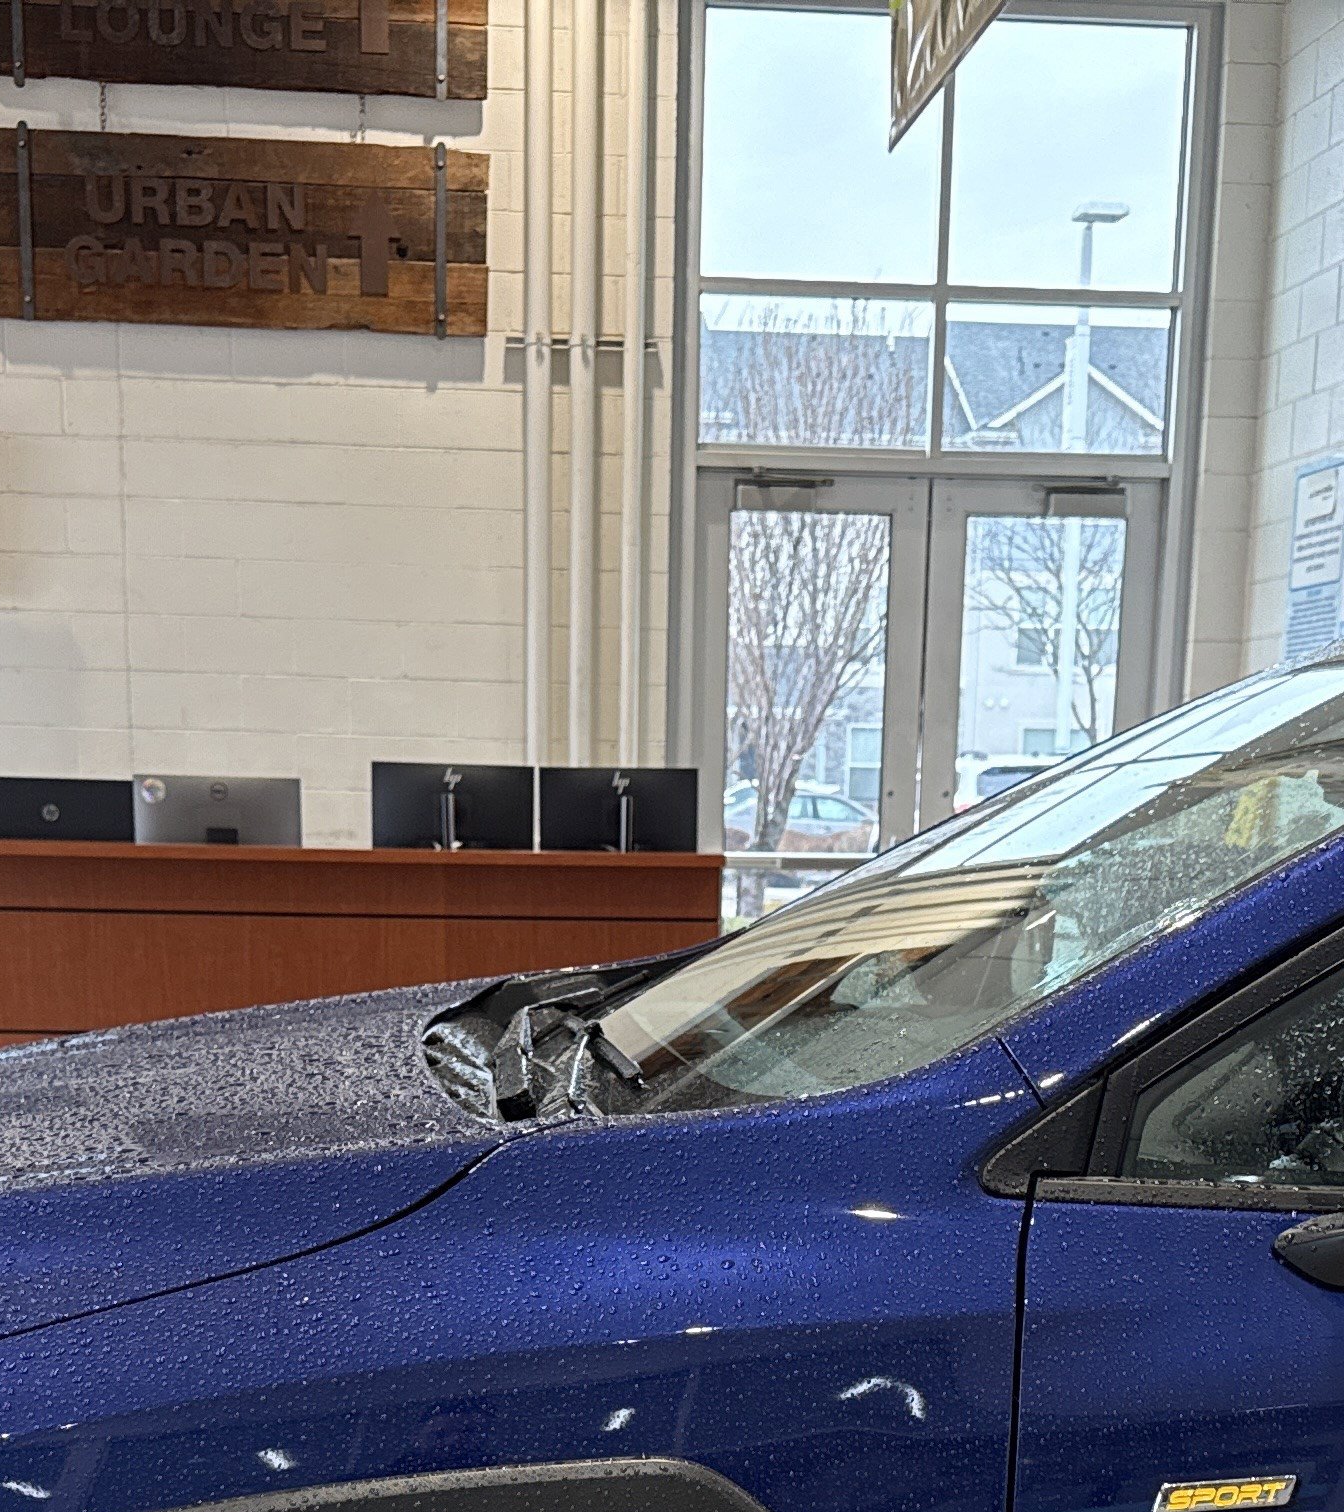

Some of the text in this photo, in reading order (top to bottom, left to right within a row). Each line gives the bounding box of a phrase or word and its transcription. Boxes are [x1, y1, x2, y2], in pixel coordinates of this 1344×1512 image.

[58, 0, 327, 51] LOUNGE
[84, 173, 307, 232] URBAN
[65, 234, 329, 296] GARDEN
[1167, 1481, 1287, 1511] SPORT
